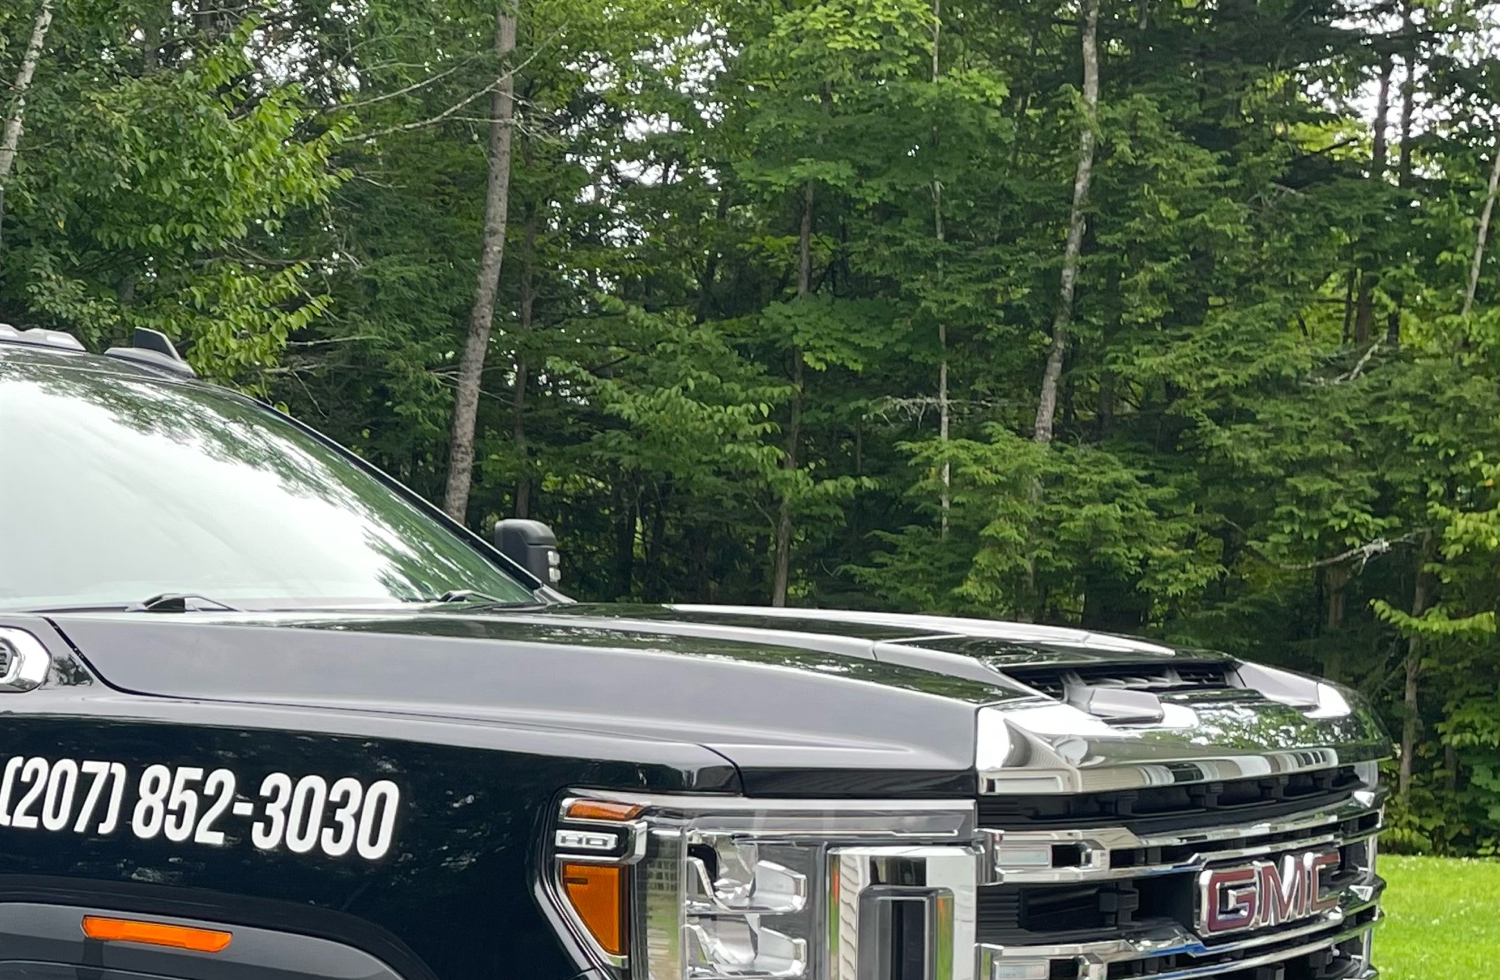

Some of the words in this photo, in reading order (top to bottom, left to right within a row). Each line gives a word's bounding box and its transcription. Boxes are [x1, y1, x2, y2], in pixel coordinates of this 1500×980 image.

[131, 764, 400, 860] 852-3030
[555, 830, 618, 850] HD
[1199, 851, 1341, 937] GMC
